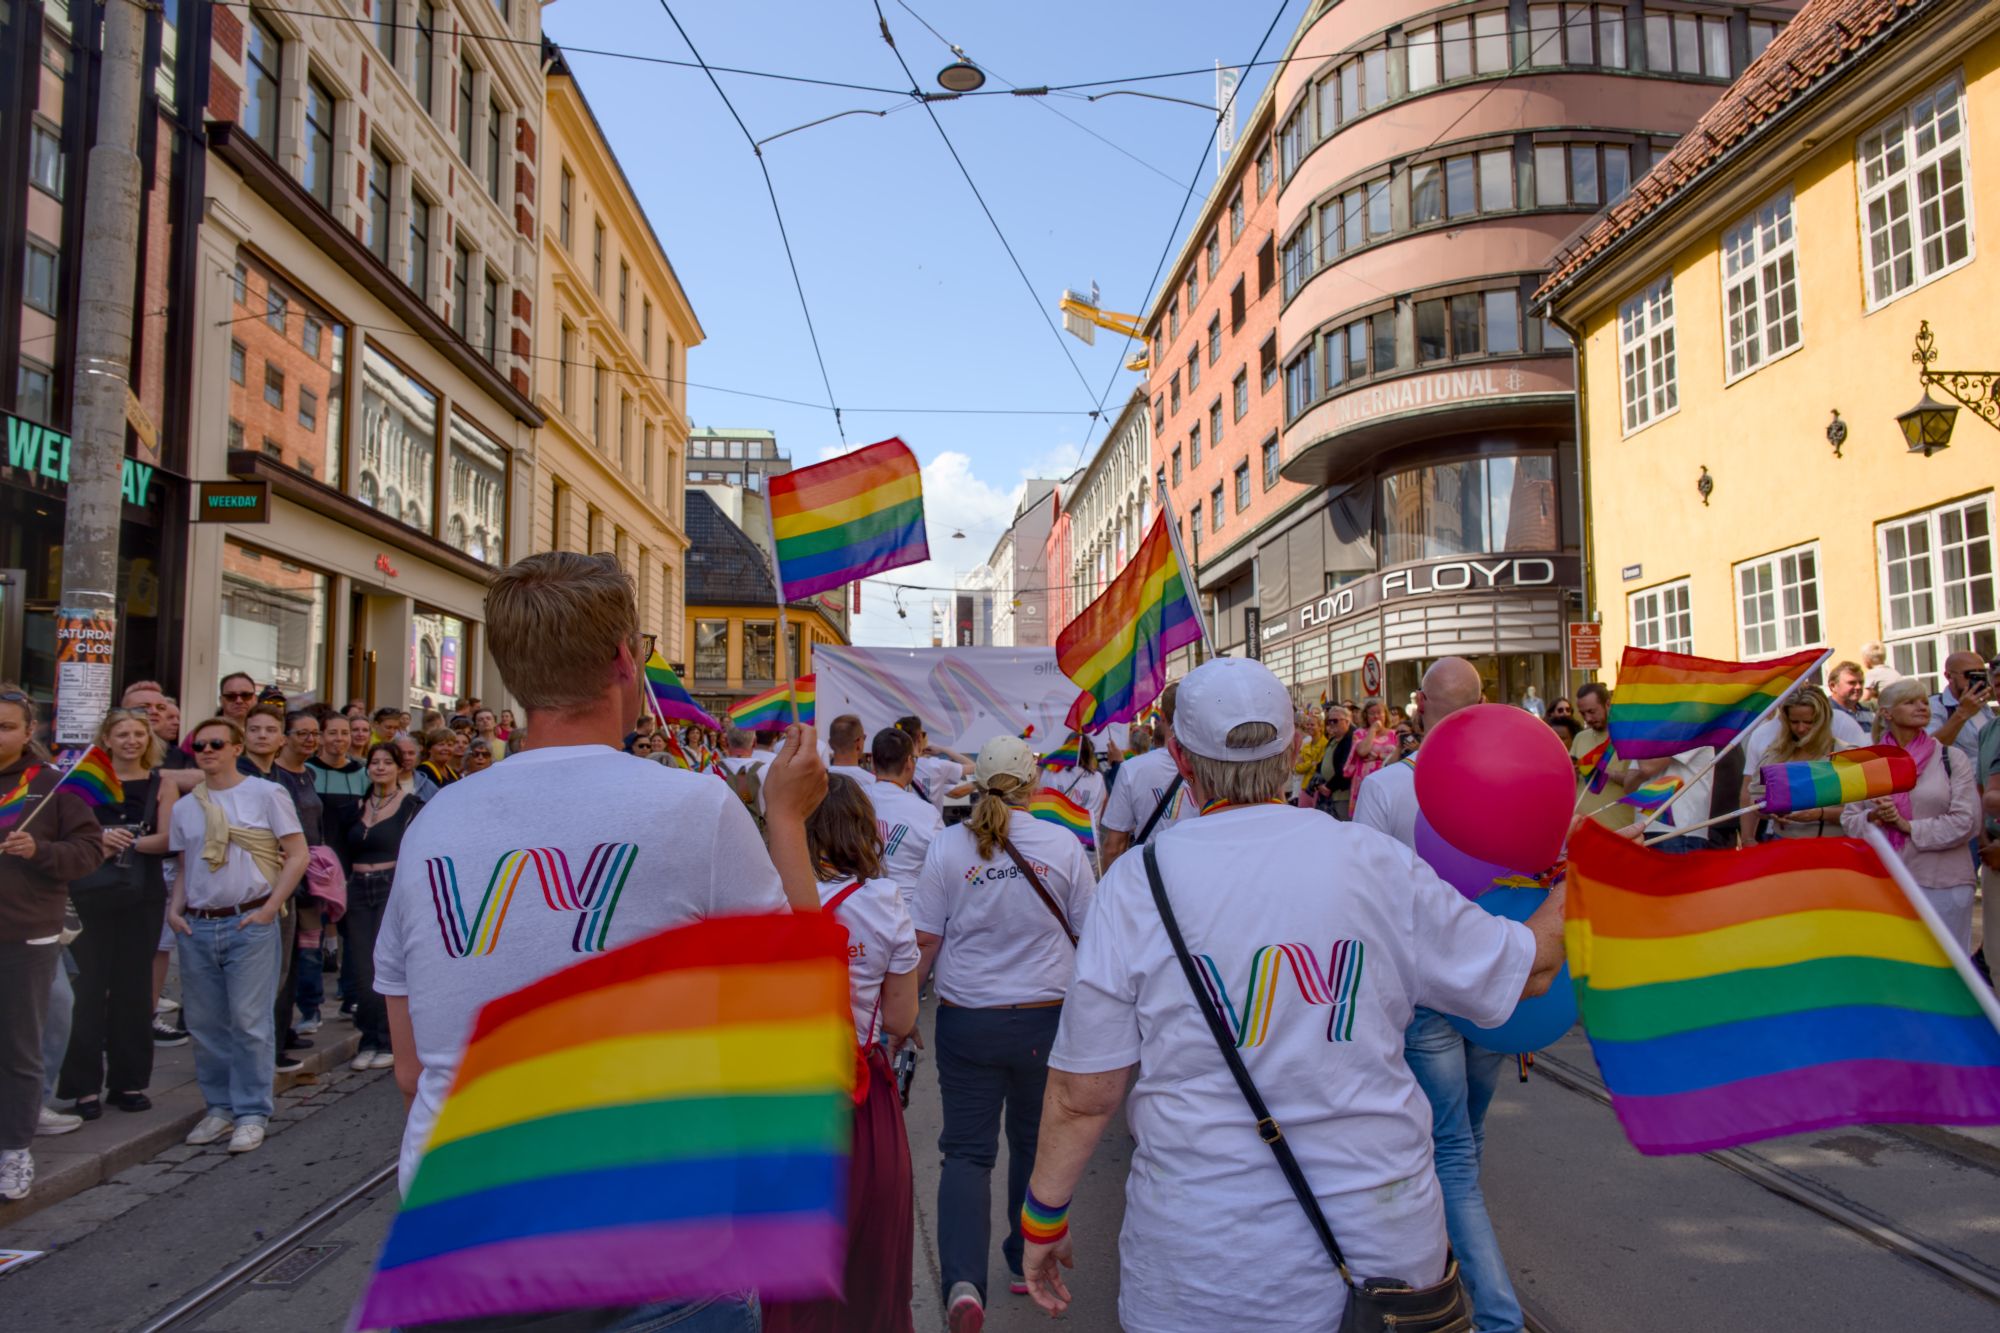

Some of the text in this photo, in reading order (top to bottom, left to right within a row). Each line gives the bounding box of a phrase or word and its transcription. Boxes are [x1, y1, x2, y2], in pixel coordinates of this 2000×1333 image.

[1335, 368, 1499, 423] INTERNATIONAL
[208, 495, 258, 508] WEEKDAY
[1382, 558, 1555, 599] FLOYD
[1301, 589, 1354, 629] FLOYD
[57, 628, 113, 640] SATURDA
[75, 643, 112, 655] CLOS
[986, 861, 1049, 880] Cargoet
[848, 942, 866, 958] et
